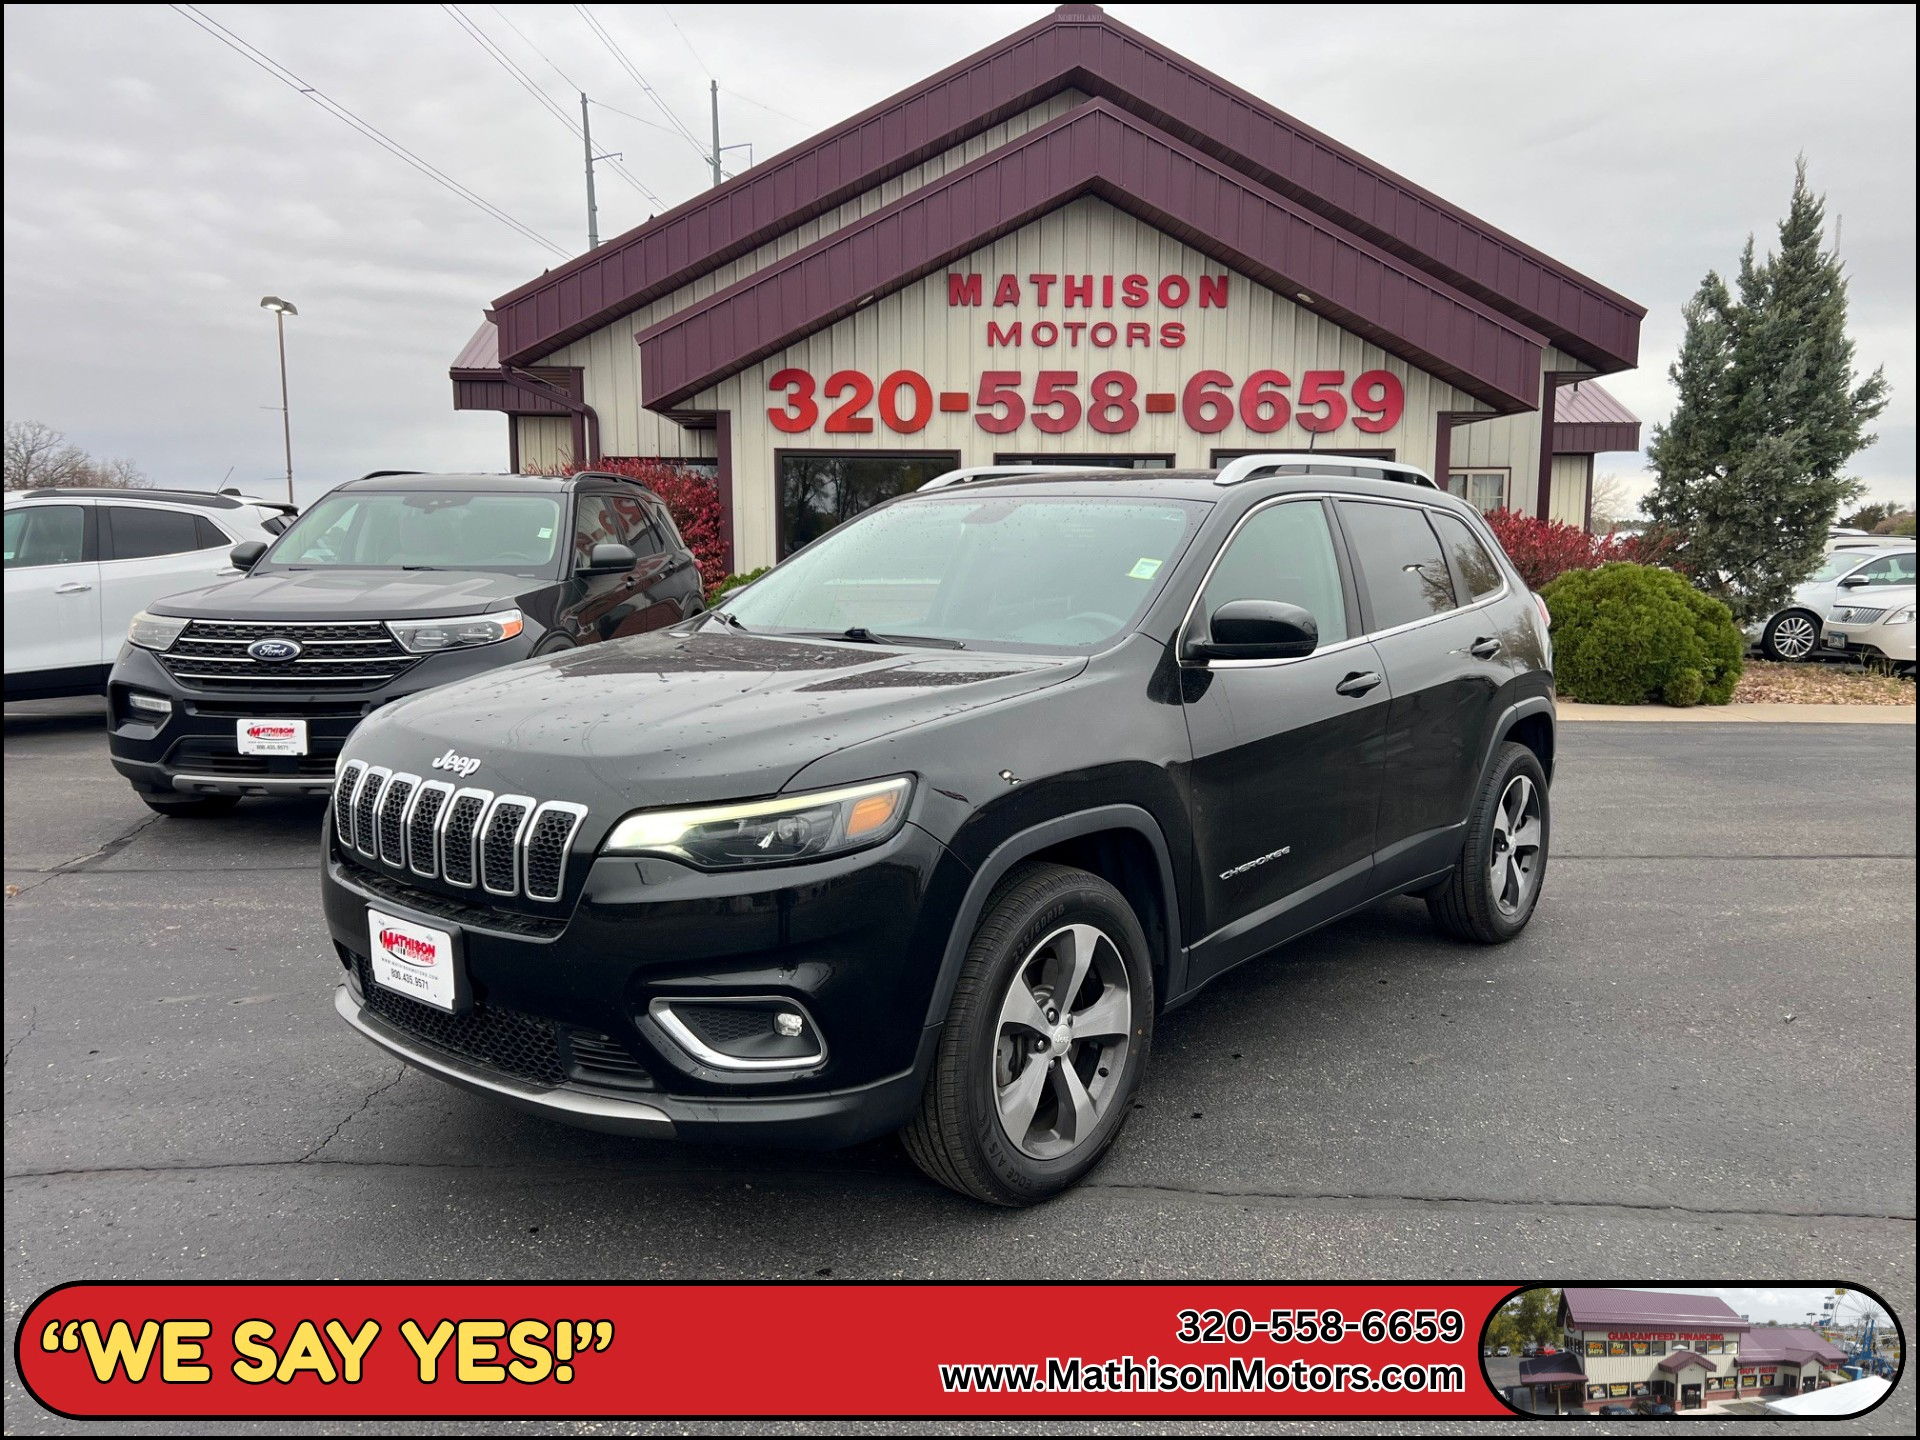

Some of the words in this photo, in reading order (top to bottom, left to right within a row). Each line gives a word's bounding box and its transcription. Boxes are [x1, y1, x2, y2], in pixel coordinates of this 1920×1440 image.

[948, 273, 1229, 308] MATHISON
[987, 321, 1187, 348] MOTORS
[767, 368, 1405, 434] 320-558-6659
[259, 643, 288, 656] Ford
[250, 727, 295, 737] MATHISON
[431, 749, 482, 779] Jeep
[1219, 845, 1291, 880] CHEROKEE
[382, 929, 436, 958] MATHISON
[406, 950, 434, 965] MOTORS
[390, 968, 429, 990] 800.435.9571
[1608, 1332, 1676, 1341] GUARANTEED
[1678, 1333, 1725, 1341] FINANCING
